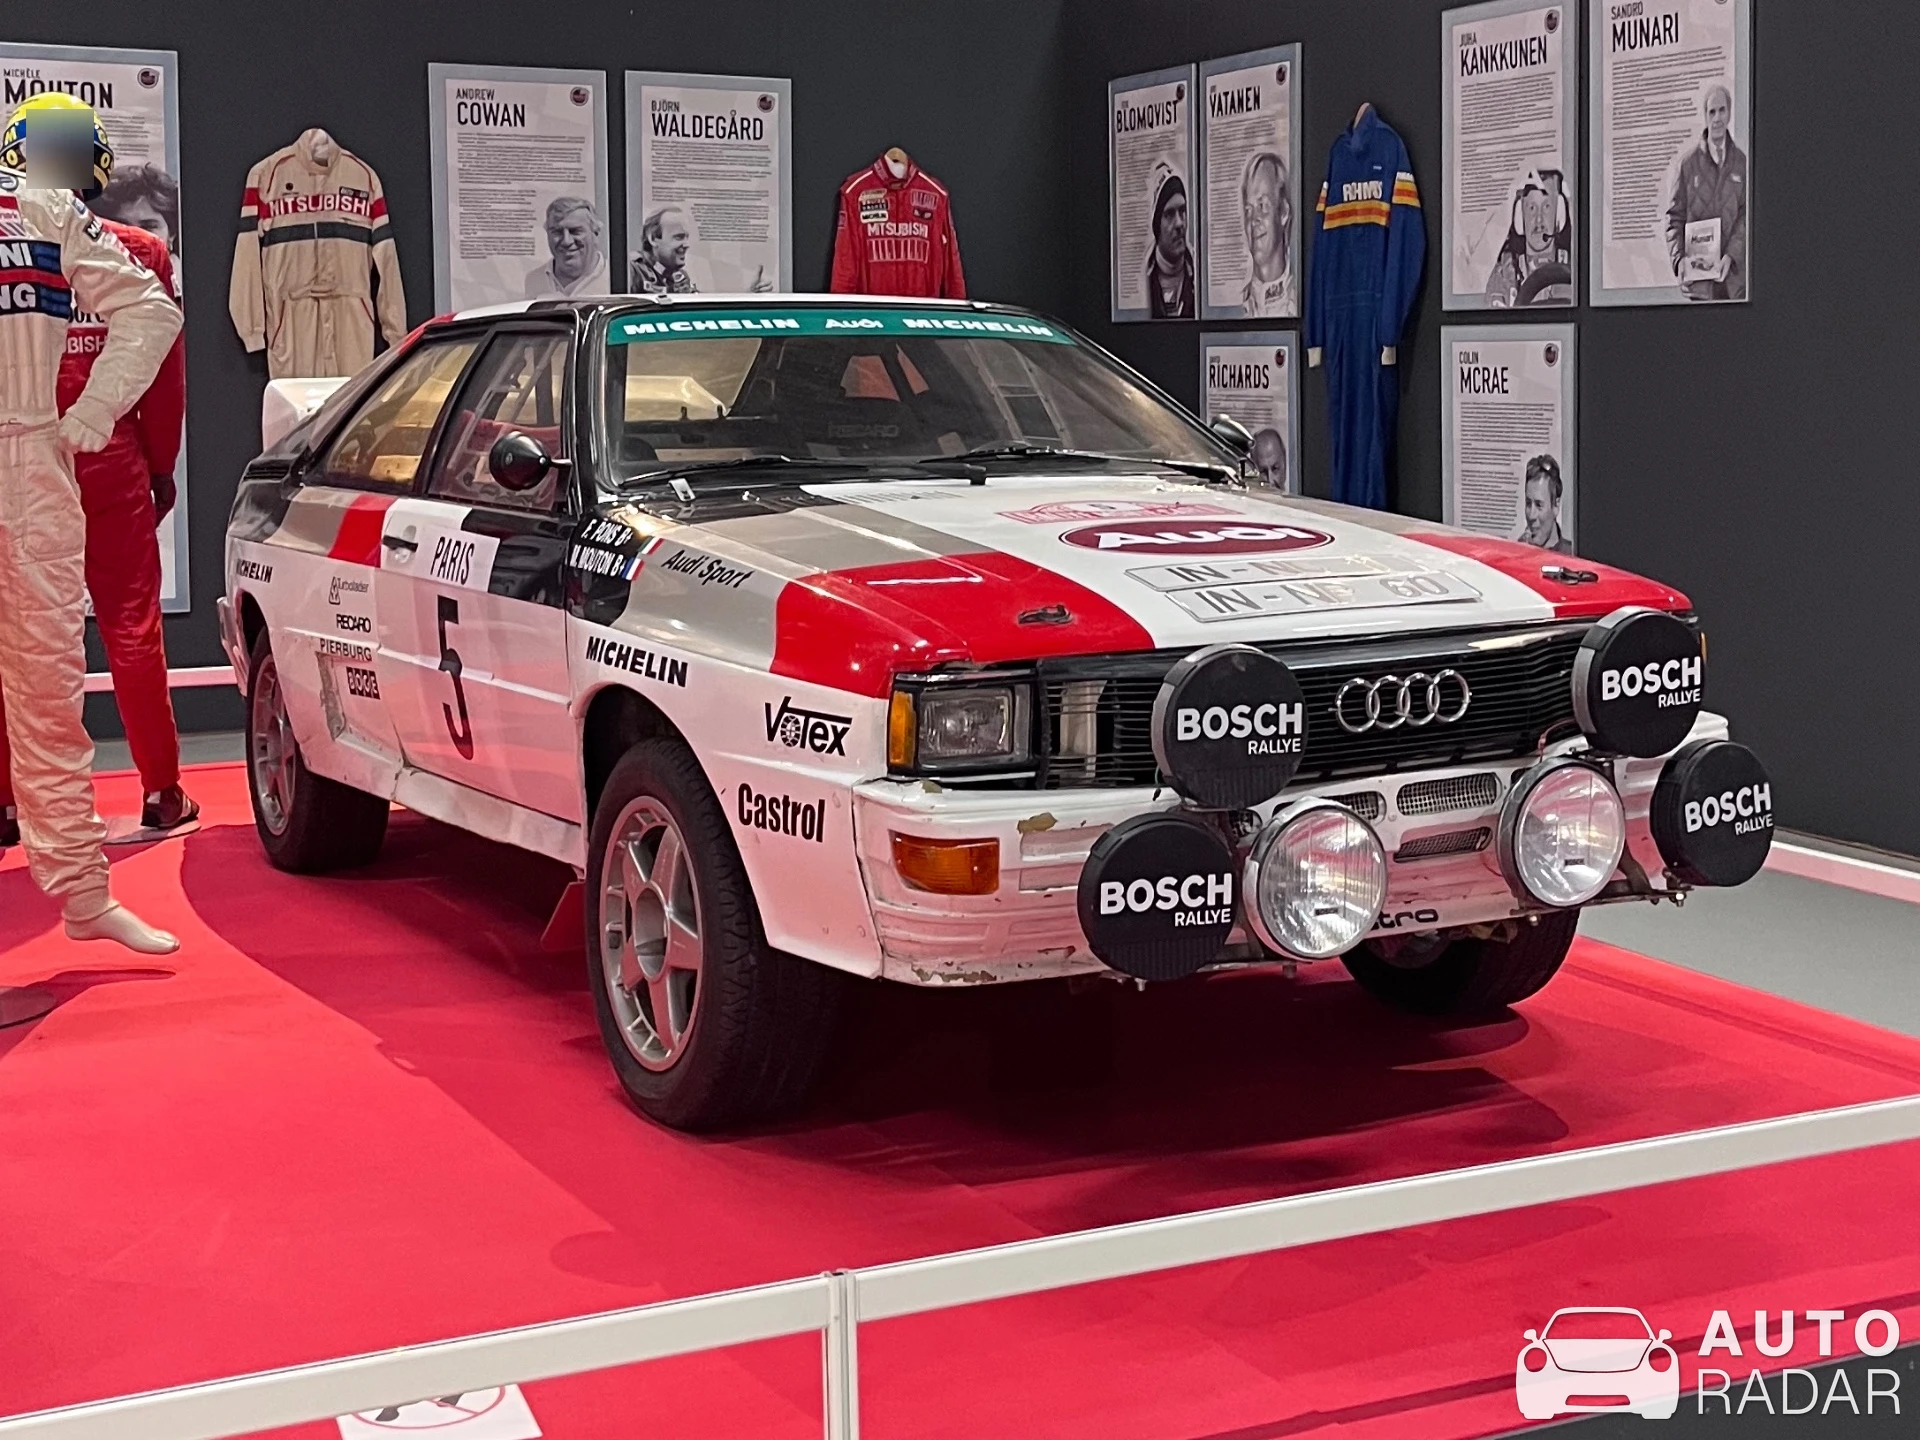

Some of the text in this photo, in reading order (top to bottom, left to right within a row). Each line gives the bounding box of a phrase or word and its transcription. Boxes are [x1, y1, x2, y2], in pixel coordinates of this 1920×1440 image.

[1611, 1, 1644, 20] SANDRO
[1612, 12, 1679, 53] MUNARI
[1461, 35, 1547, 77] KANKKUNEN
[3, 68, 41, 79] MICHÈLE
[456, 88, 495, 101] ANDREW
[651, 99, 680, 112] BJÖRN
[1210, 85, 1261, 118] VATANEN
[457, 101, 525, 127] COWAN
[652, 109, 764, 140] WALDEGÅRD
[1116, 100, 1178, 133] BLOMQVIST
[270, 194, 371, 217] MITSUBISHI
[623, 317, 799, 336] MICHELIN
[903, 319, 1053, 337] MICHELIN
[1459, 351, 1478, 365] COLIN
[1209, 364, 1270, 390] RICHARDS
[1460, 366, 1509, 394] MCRAE
[429, 536, 475, 586] PARIS
[661, 549, 755, 589] Audi Sport
[1380, 575, 1449, 599] 60
[336, 613, 372, 633] RECARO
[320, 638, 372, 662] PIERBURG
[586, 636, 688, 688] MICHELIN
[437, 595, 474, 760] 5
[1602, 656, 1701, 701] BOSCH
[1658, 689, 1701, 708] RALLYE
[1177, 703, 1303, 741] BOSCH
[1247, 738, 1302, 755] RALLYE
[738, 783, 826, 843] Castrol
[1684, 782, 1772, 833] BOSCH
[1734, 814, 1774, 836] RALLYE
[1100, 873, 1233, 915] BOSCH
[1174, 908, 1232, 927] RALLYE
[1371, 908, 1439, 931] tro
